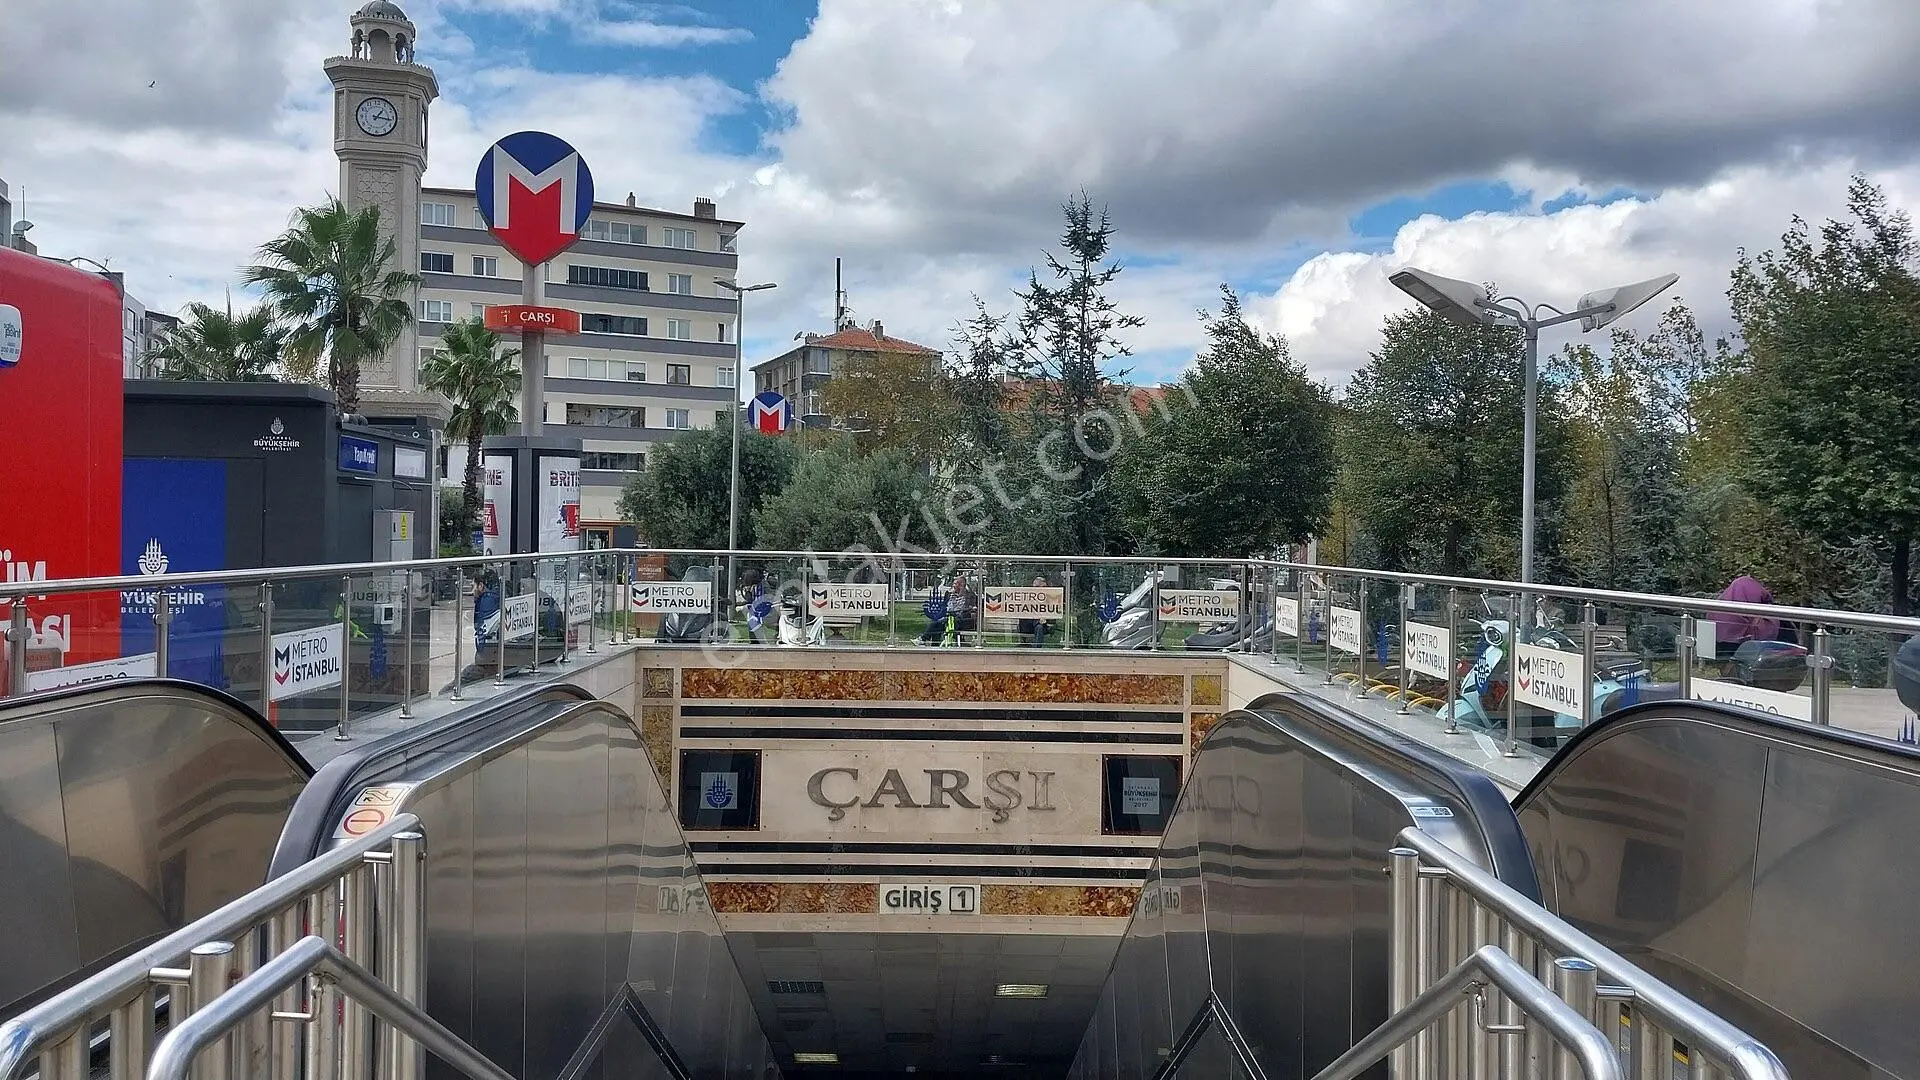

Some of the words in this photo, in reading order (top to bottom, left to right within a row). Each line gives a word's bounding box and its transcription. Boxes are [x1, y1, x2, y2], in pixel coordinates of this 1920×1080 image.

[519, 311, 555, 325] ÇARŞI
[253, 438, 300, 448] BÜYÜKŞEHİR
[549, 470, 580, 487] BRITI
[120, 588, 205, 605] YÜKEHİR
[652, 586, 695, 596] METRO
[831, 588, 872, 598] METRO
[1004, 592, 1046, 602] METRO
[652, 597, 711, 609] İSTANBUL
[831, 598, 888, 610] İSTANBUL
[1178, 595, 1221, 605] METRO
[120, 606, 185, 614] BELEDESİ
[1004, 602, 1061, 614] İSTANBUL
[1178, 604, 1237, 619] İSTANBUL
[1416, 631, 1439, 649] METRO
[292, 636, 328, 660] METRO
[1416, 646, 1447, 673] İSTANBUL
[292, 656, 340, 684] İSTANBUL
[1532, 656, 1565, 679] METRO
[1532, 674, 1578, 709] İSTANBUL
[806, 767, 1057, 823] ÇARŞI
[885, 885, 942, 913] GİRİŞ
[957, 890, 966, 909] 1
